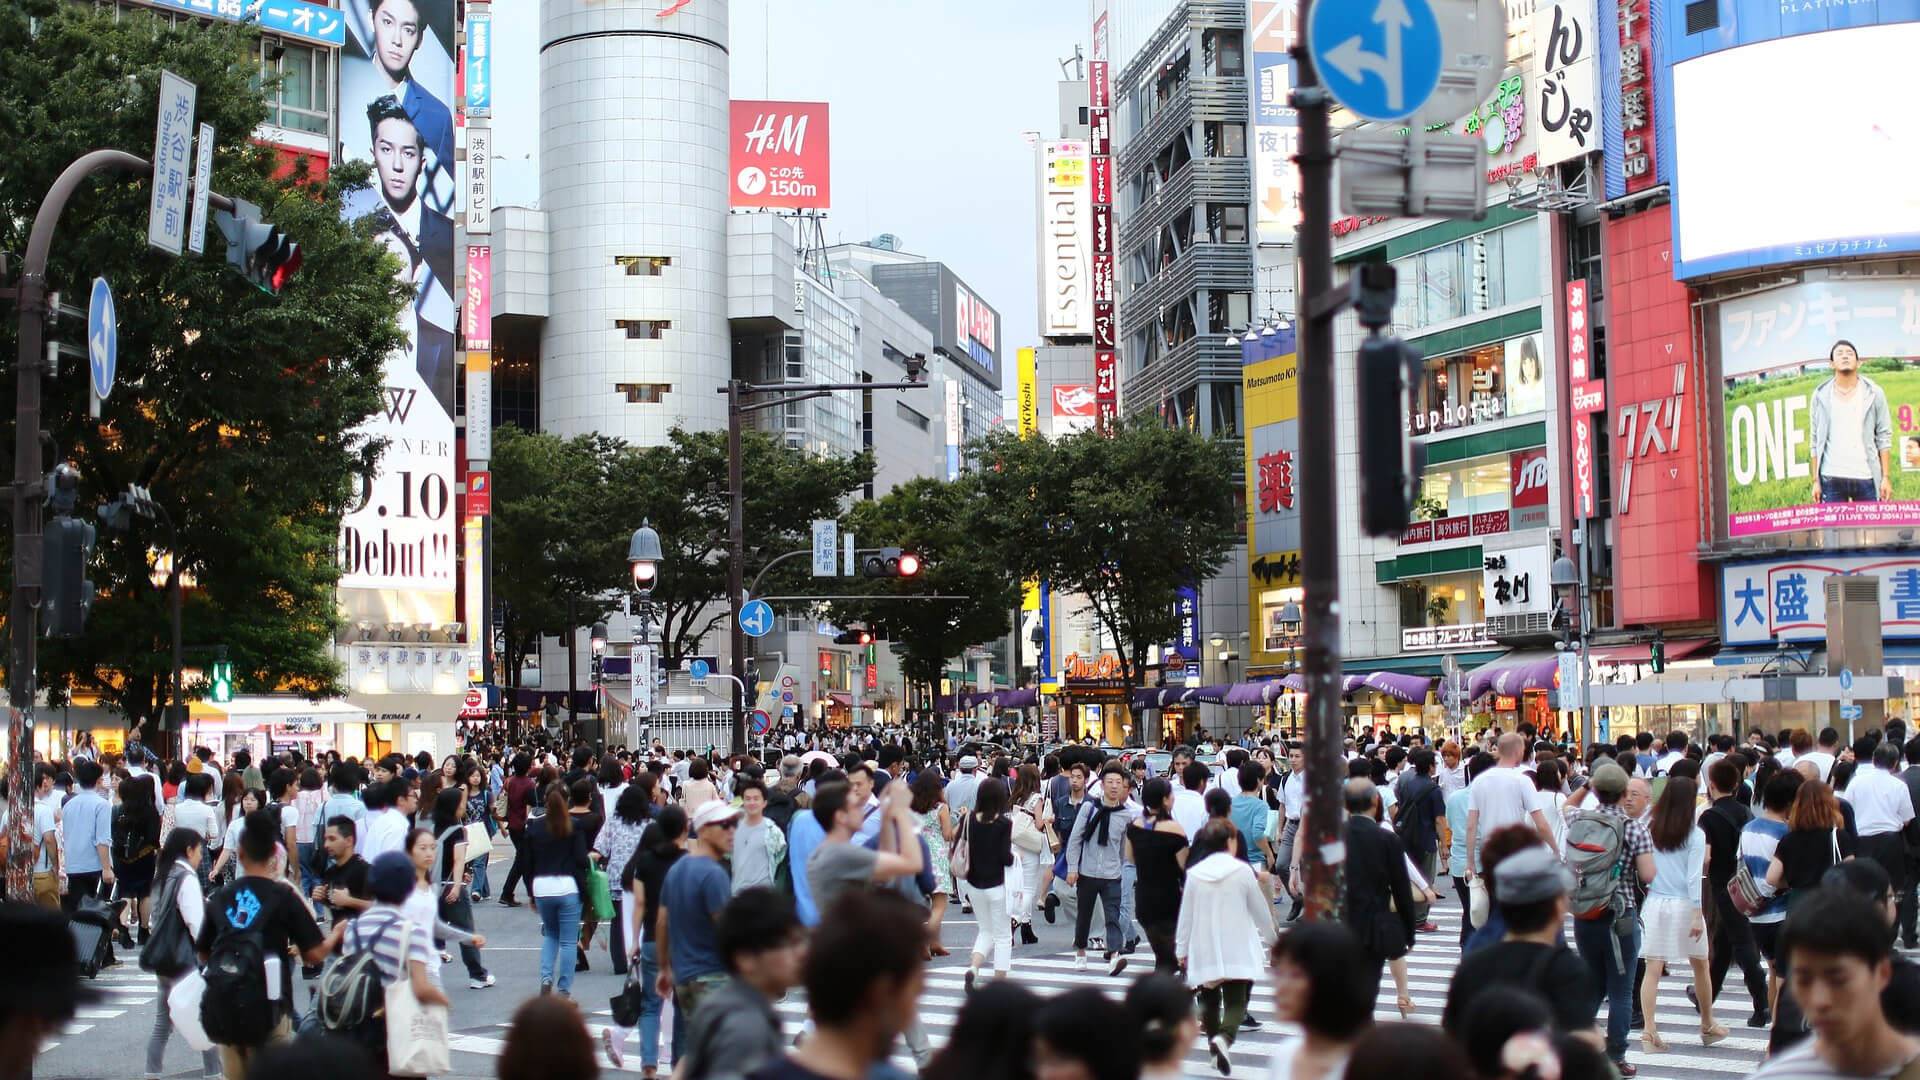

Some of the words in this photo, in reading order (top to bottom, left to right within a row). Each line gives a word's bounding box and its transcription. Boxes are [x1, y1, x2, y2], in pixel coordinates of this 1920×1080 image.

[1780, 0, 1877, 14] PLATIN
[1541, 4, 1593, 148] んじゃ
[159, 109, 172, 175] Shibuya
[744, 113, 808, 156] H&M
[165, 93, 190, 238] 渋谷駅前
[472, 138, 485, 223] 渋谷駅前ビル
[769, 167, 804, 179] この先
[156, 182, 167, 213] Sta.
[769, 180, 817, 197] 150m
[469, 247, 489, 258] 5F
[1049, 191, 1078, 329] Essential
[1794, 238, 1888, 256] ミュゼプラチナム
[1571, 287, 1586, 379] お好み焼
[1247, 371, 1285, 389] Matsumoto
[1618, 362, 1687, 515] クスリ
[1899, 404, 1920, 432] 9.
[1732, 395, 1810, 485] ONE
[1257, 449, 1294, 514] 薬
[1515, 456, 1548, 496] JTB
[1437, 520, 1467, 536] 海外旅行
[1475, 512, 1507, 525] ハネムーン
[344, 526, 449, 579] Debut!!
[823, 524, 833, 572] 渋谷駅前
[1734, 568, 1920, 627] 大盛書
[359, 650, 462, 665] 渋谷駅前ビル
